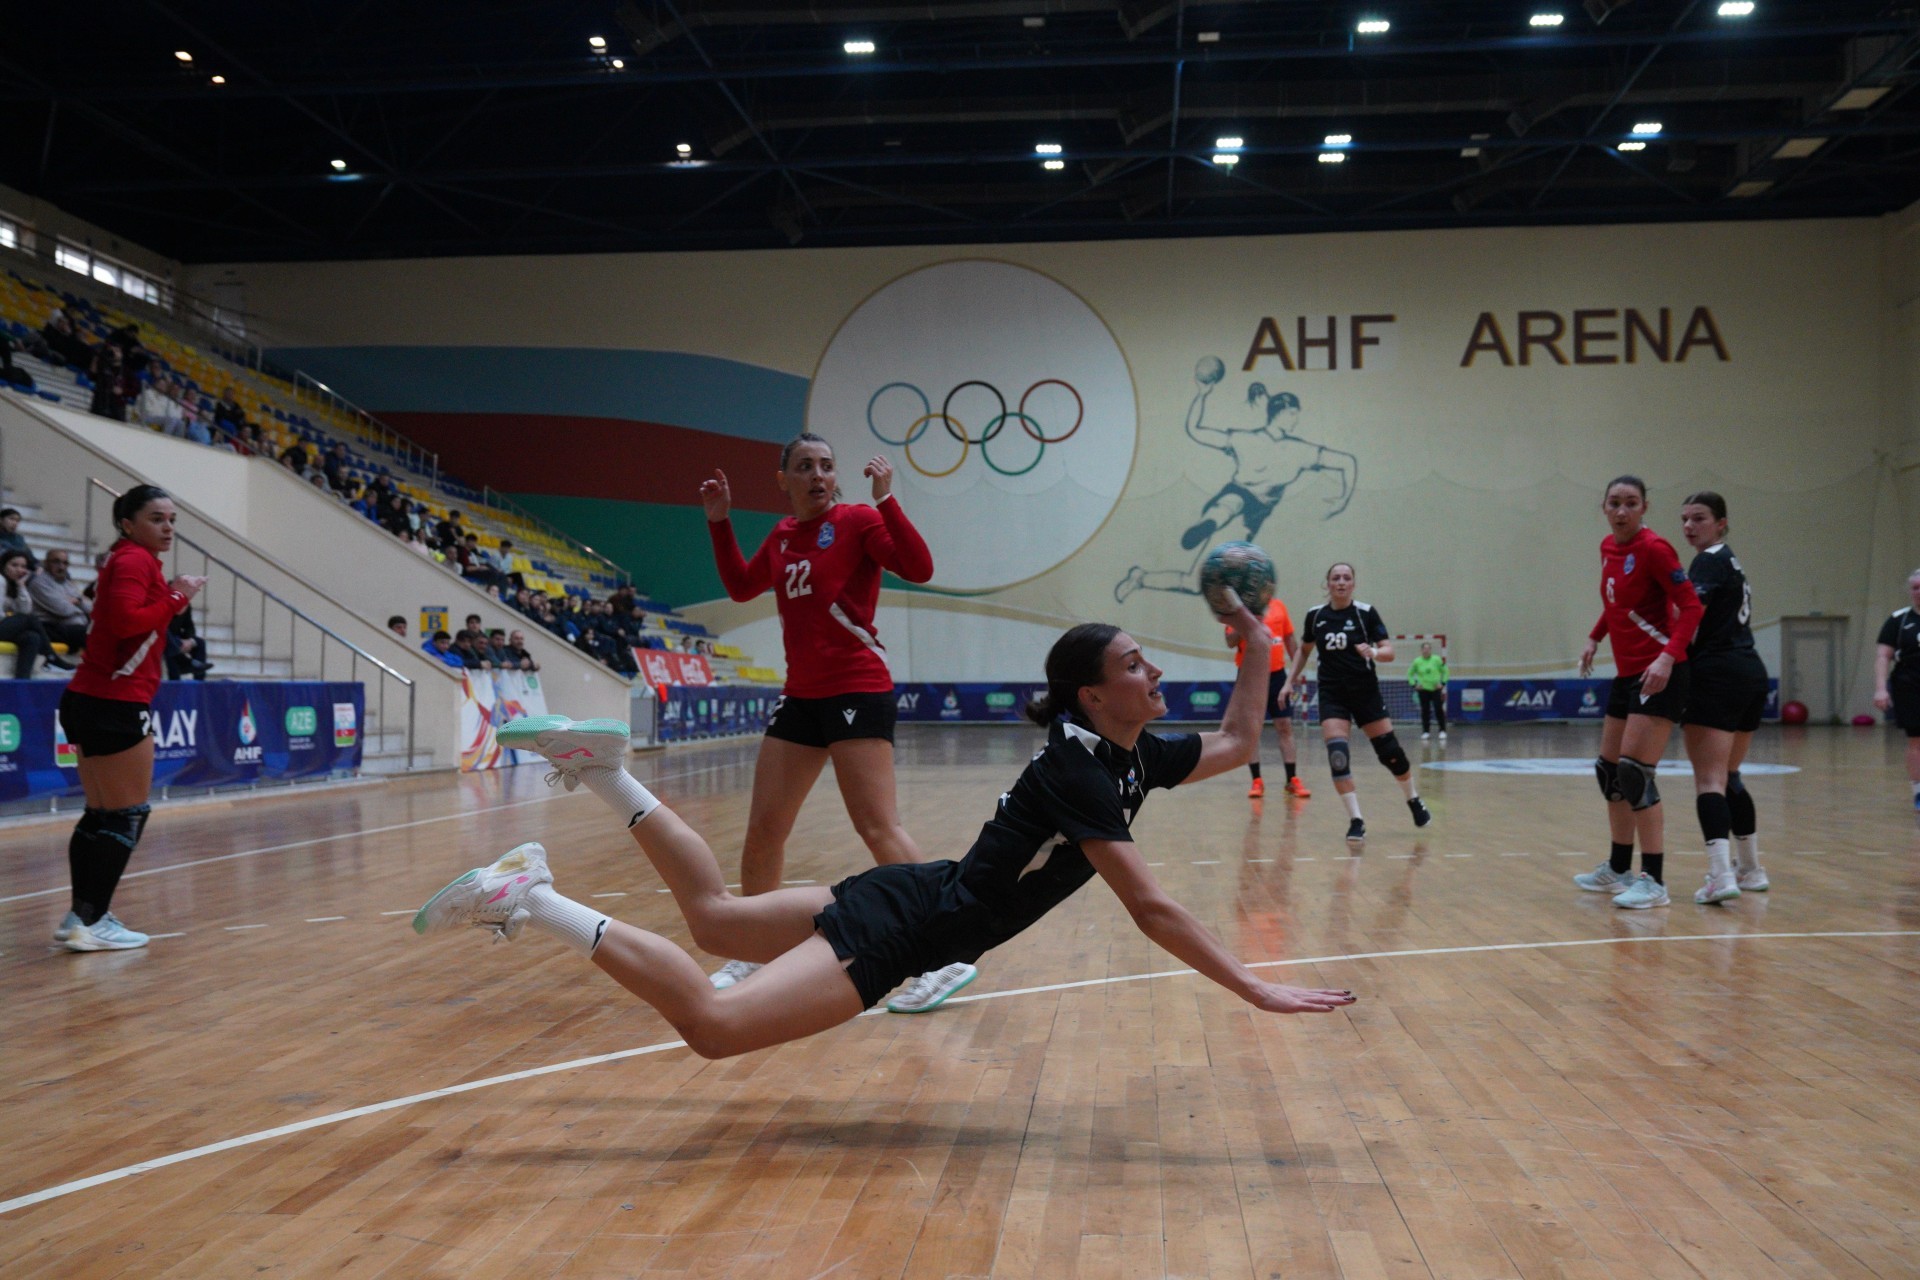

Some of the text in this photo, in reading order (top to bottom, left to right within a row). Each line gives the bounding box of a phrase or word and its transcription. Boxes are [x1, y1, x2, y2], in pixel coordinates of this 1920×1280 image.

[1242, 305, 1732, 371] AHF ARENA
[785, 559, 813, 599] 22
[1606, 577, 1616, 603] 6
[428, 614, 442, 631] B
[1325, 632, 1348, 650] 20
[1517, 689, 1557, 706] AAY
[291, 710, 313, 731] AZE
[234, 747, 262, 760] AHF
